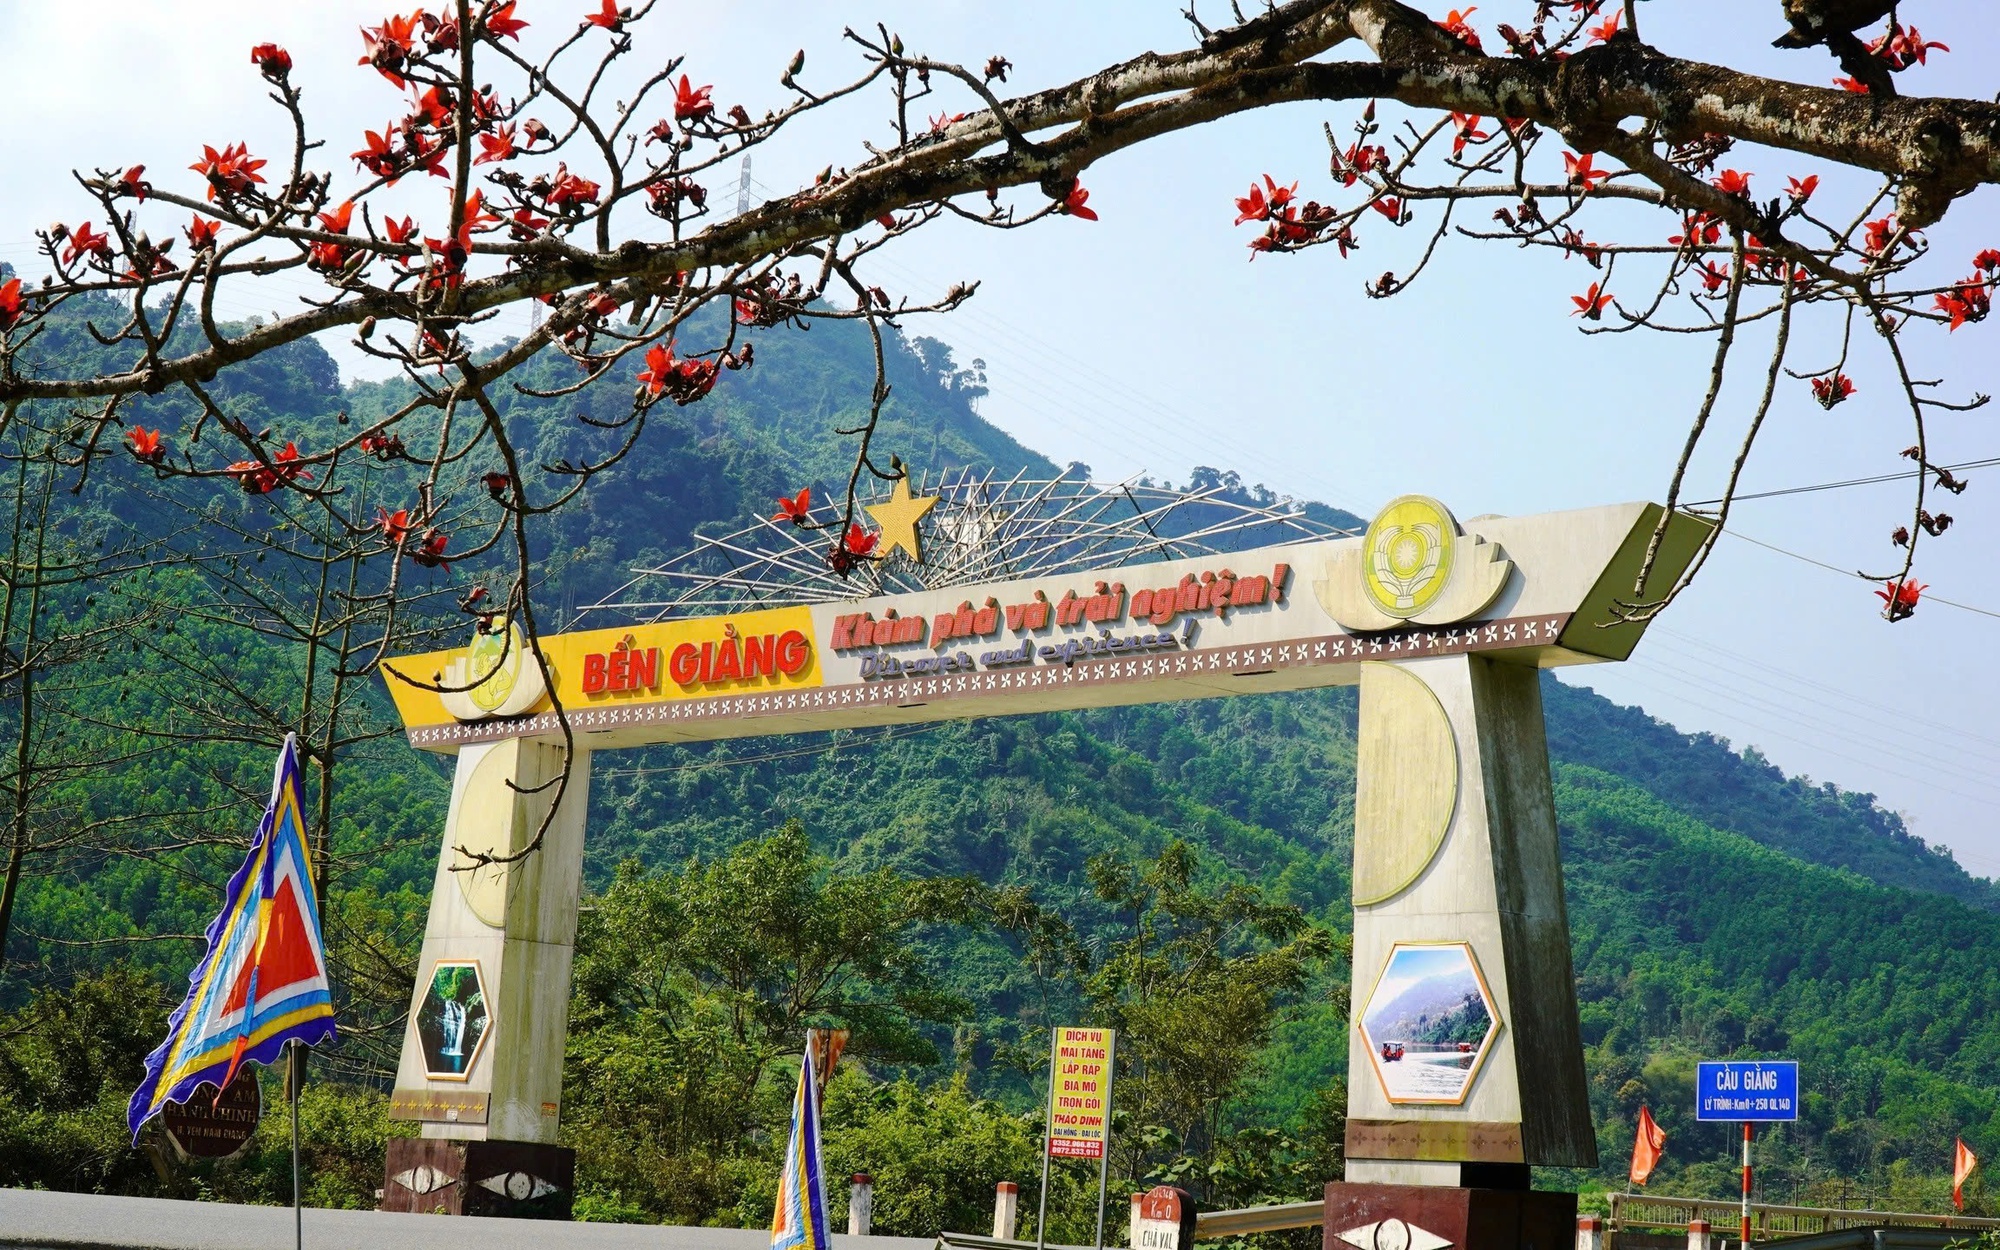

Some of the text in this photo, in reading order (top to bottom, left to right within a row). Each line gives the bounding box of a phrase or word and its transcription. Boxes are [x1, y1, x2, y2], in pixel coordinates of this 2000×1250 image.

[830, 607, 927, 650] Khám
[930, 596, 1000, 650] phá
[1006, 589, 1053, 631] và
[1056, 580, 1125, 626] trải
[582, 633, 662, 694] BẾN
[859, 651, 972, 677] Discover
[980, 638, 1034, 666] and
[1066, 1030, 1102, 1044] DỊCH VỤ
[1060, 1047, 1078, 1058] MAI
[1716, 1063, 1777, 1090] CẦU GIẰNG
[1064, 1079, 1097, 1095] BIA MỘ
[1059, 1096, 1101, 1110] TRỌN GÓI
[1704, 1096, 1712, 1111] LÝ
[1054, 1111, 1103, 1126] THẢO DINH
